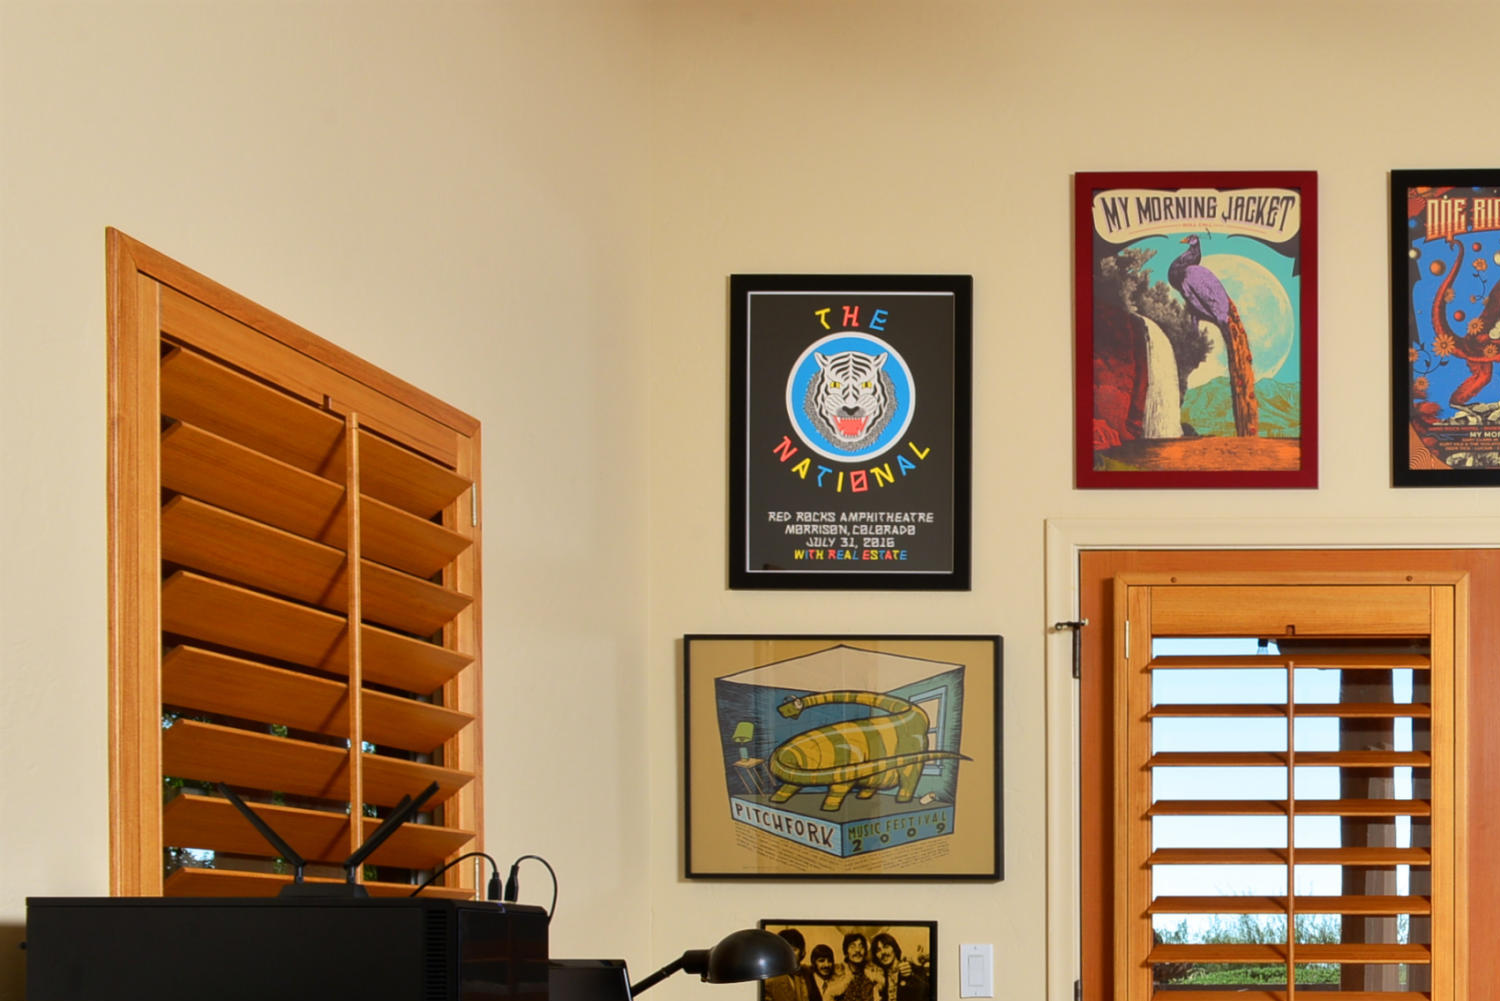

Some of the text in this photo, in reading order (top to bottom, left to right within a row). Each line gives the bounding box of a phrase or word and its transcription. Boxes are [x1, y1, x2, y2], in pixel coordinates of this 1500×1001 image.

[1100, 195, 1297, 233] MY MORNING JACKET
[1424, 197, 1467, 244] ONE
[815, 305, 888, 331] THE
[1469, 430, 1485, 438] MY
[773, 435, 931, 493] NATIONAL
[768, 511, 935, 524] RED ROCKS AMPHITHEATRE
[785, 524, 916, 537] MORRISON, COLORADO
[806, 537, 896, 549] JULY 31, 2016
[794, 549, 909, 561] WITH REAL ESTATE
